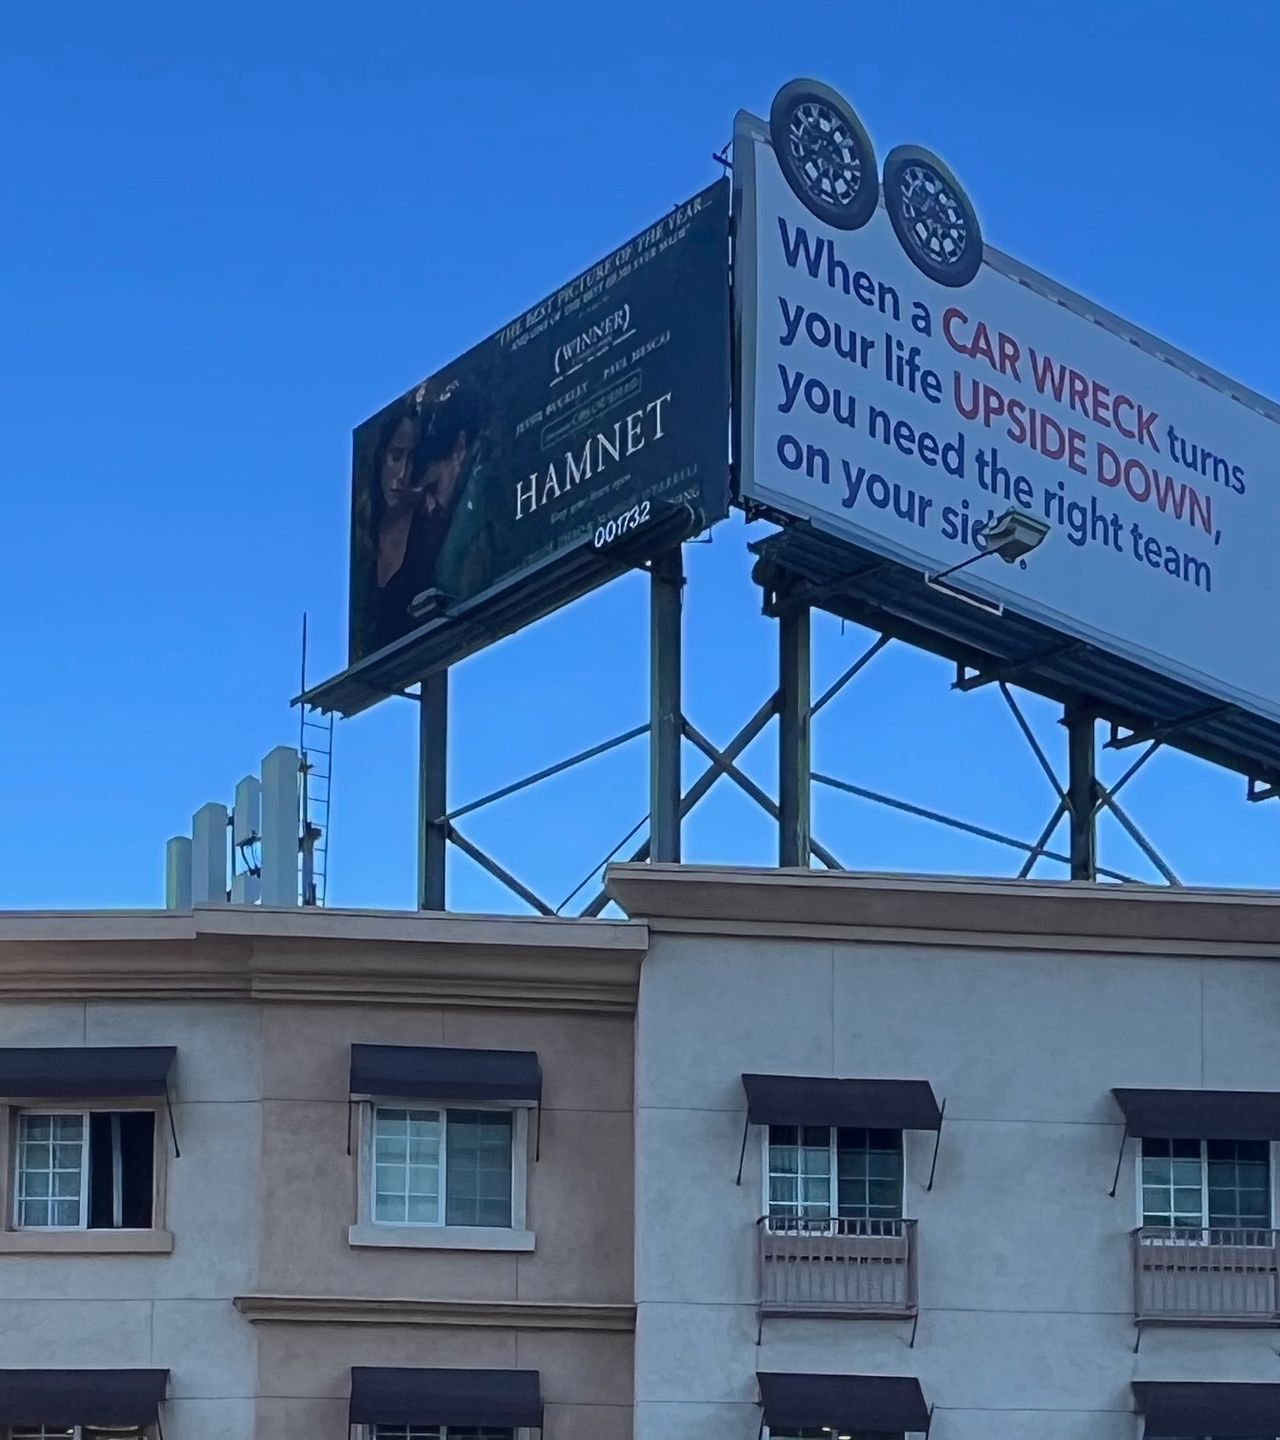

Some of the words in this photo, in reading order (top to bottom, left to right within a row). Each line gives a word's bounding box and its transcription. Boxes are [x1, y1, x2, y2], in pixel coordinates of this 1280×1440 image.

[636, 219, 666, 253] THE
[778, 216, 900, 321] When
[911, 301, 932, 338] a
[943, 307, 1022, 382] CAR
[1028, 347, 1160, 454] WRECK
[1167, 424, 1246, 494] turns
[515, 391, 672, 520] HAMNET
[777, 363, 856, 428] you
[869, 405, 965, 479] need
[975, 448, 1034, 509] the
[1044, 481, 1123, 552] right
[1130, 523, 1212, 592] team
[777, 434, 830, 484] on
[841, 459, 932, 527] your
[778, 296, 875, 369] your
[885, 333, 942, 403] life
[954, 370, 1088, 476] UPSIDE
[1097, 442, 1222, 546] DOWN,
[593, 500, 651, 548] 001732
